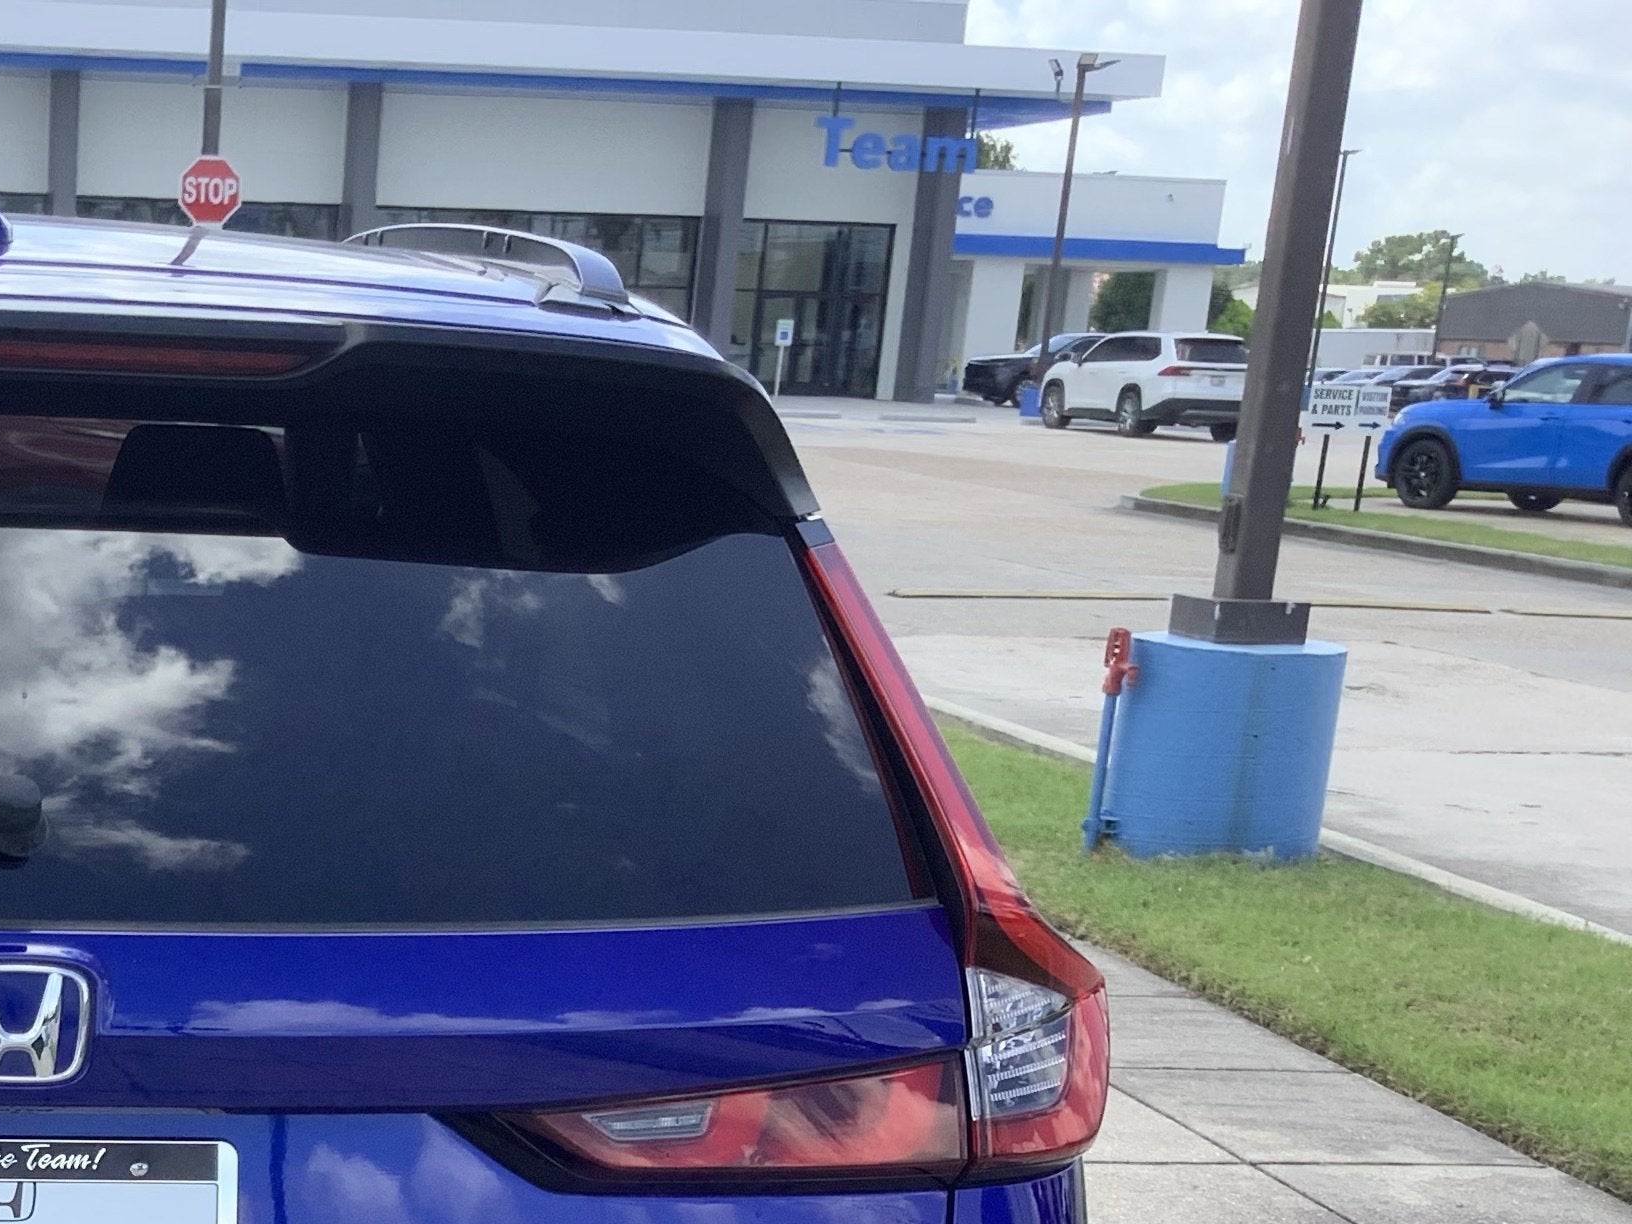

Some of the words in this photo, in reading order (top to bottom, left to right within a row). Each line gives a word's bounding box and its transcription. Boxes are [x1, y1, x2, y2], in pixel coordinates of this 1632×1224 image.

[815, 116, 977, 174] Team
[183, 176, 237, 205] STOP
[1314, 388, 1354, 400] SERVICE
[1311, 403, 1317, 415] &
[1321, 404, 1351, 416] PARTS
[21, 1143, 106, 1171] Team!
